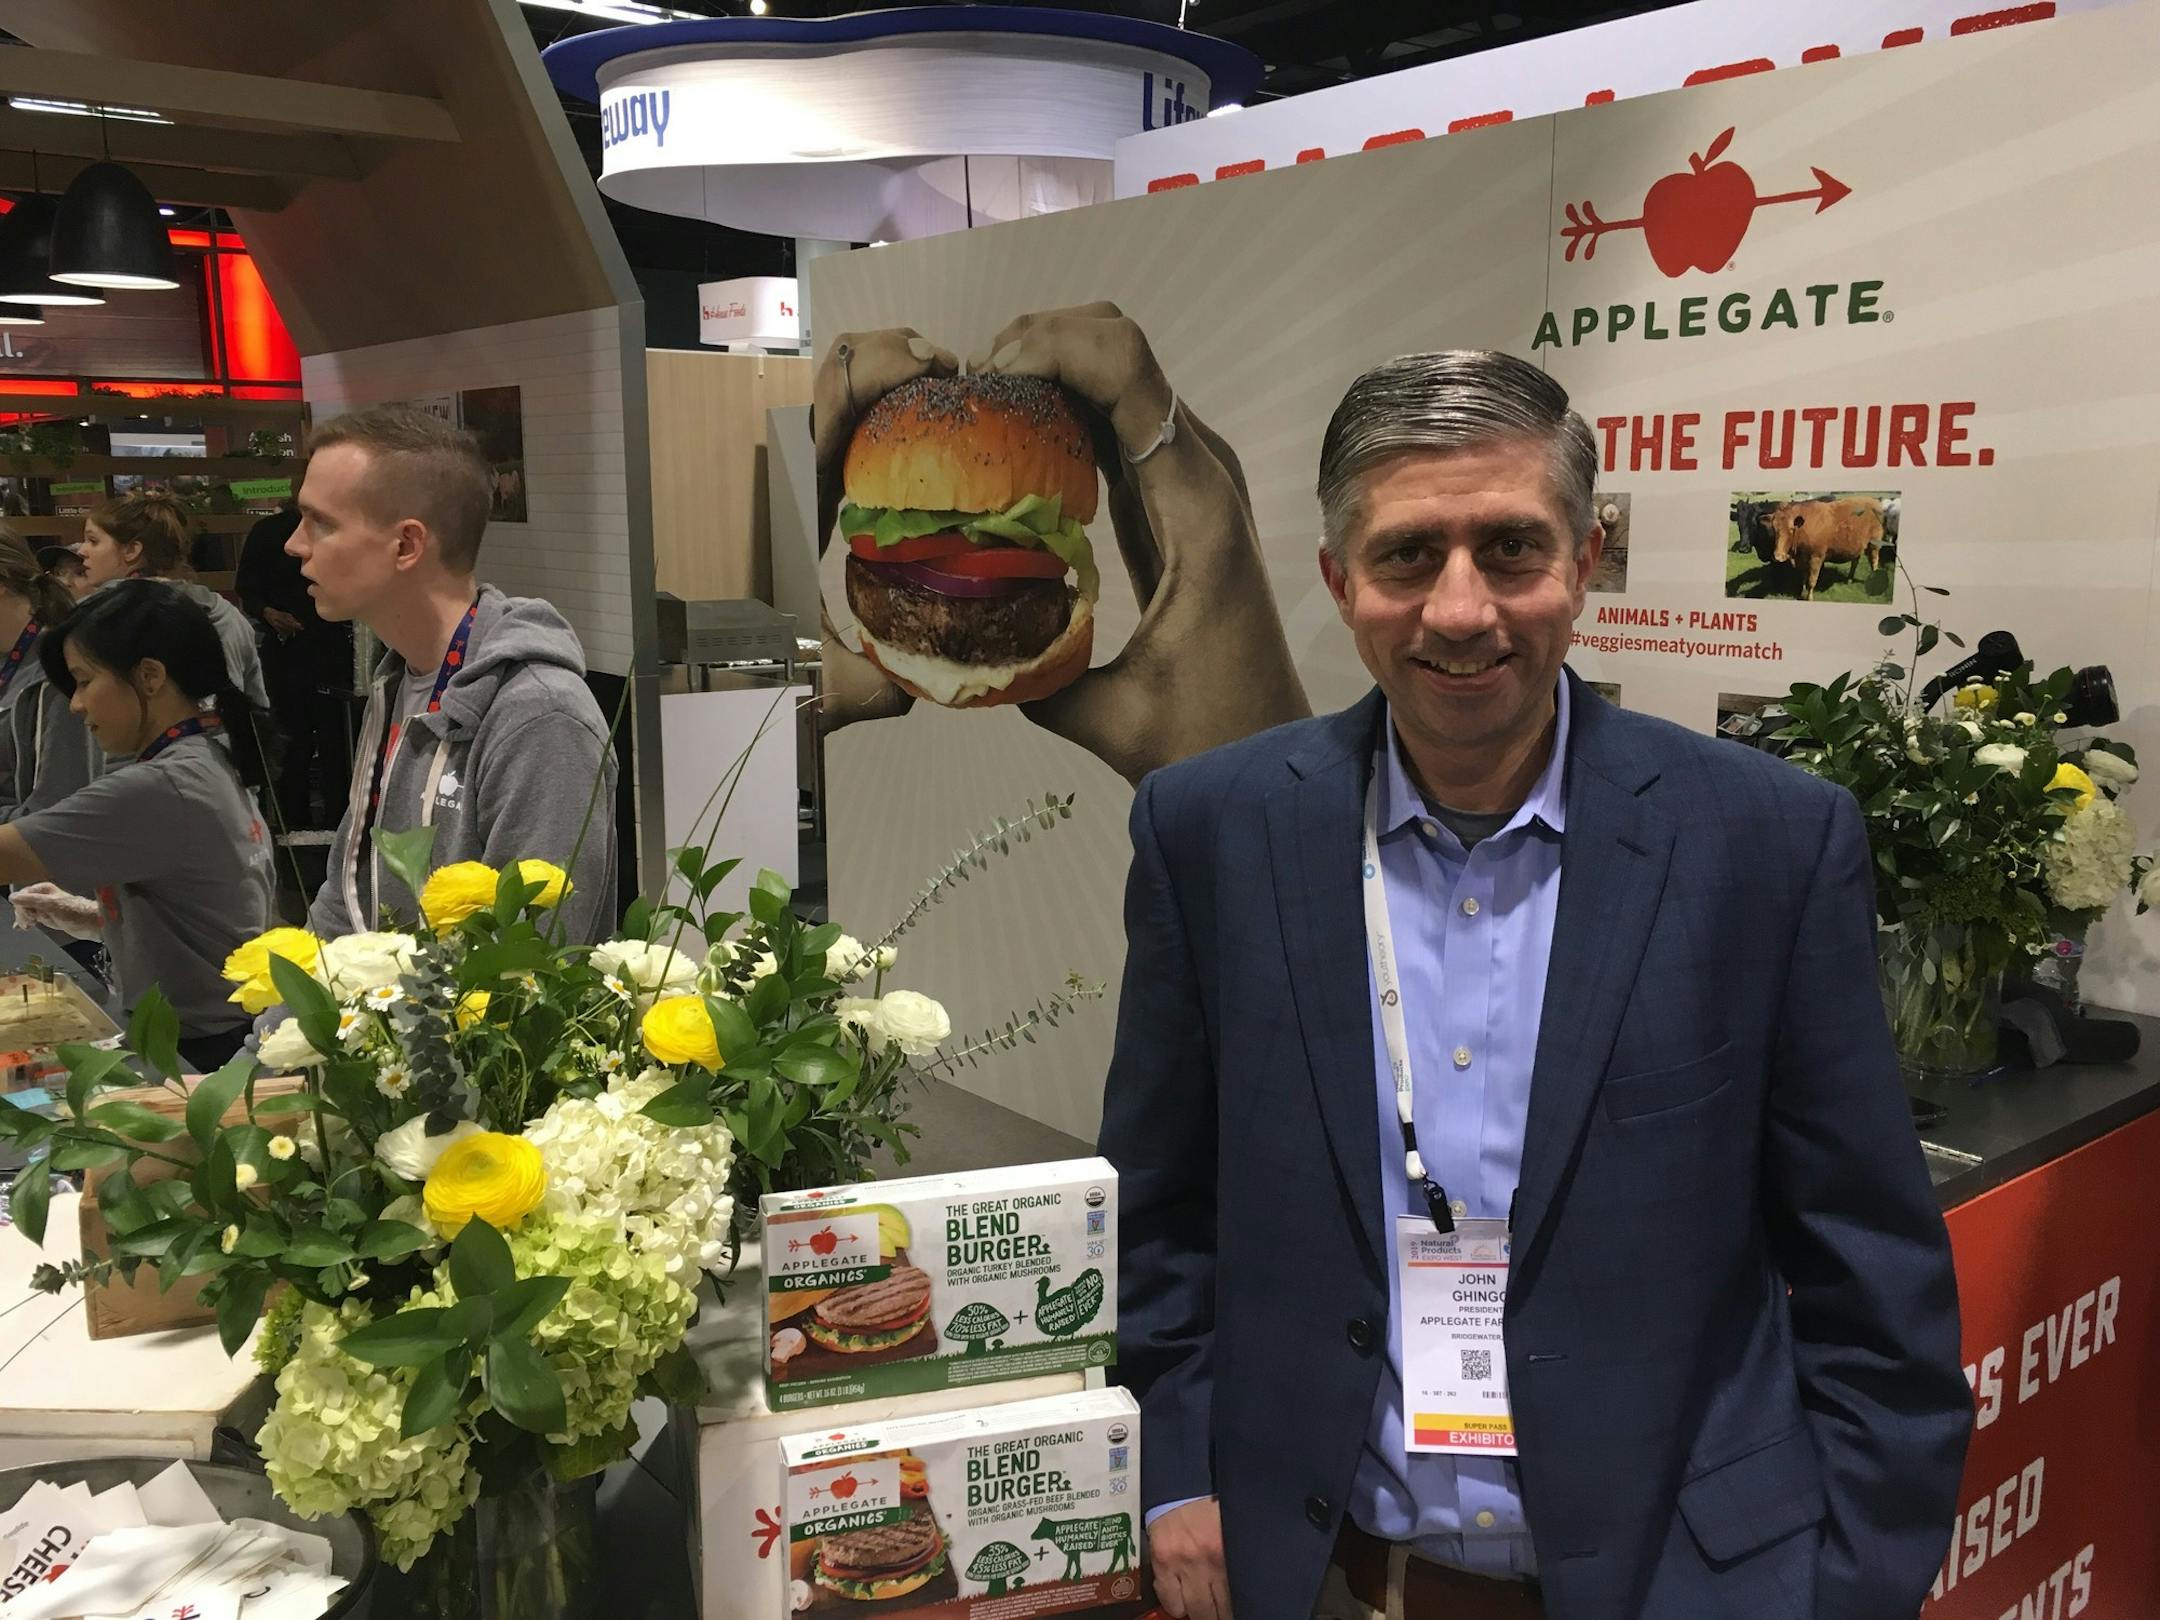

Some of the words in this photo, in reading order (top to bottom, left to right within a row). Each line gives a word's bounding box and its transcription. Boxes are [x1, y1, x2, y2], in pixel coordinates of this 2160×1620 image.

[1597, 413, 1701, 472] THE
[1722, 402, 1995, 470] FUTURE.
[1597, 607, 1669, 627] ANIMALS
[1689, 611, 1757, 632] PLANTS
[1571, 630, 1783, 661] #veggiesmeatyourmatch
[946, 1204, 968, 1217] THE
[973, 1200, 1008, 1214] GREAT
[1013, 1193, 1062, 1210] ORGANIC
[946, 1212, 1020, 1242] BLEND
[782, 1254, 868, 1271] APPLEGATE
[947, 1265, 982, 1278] ORGANIC
[983, 1261, 1013, 1272] TURKEY
[1015, 1256, 1052, 1268] BLENDED
[783, 1269, 866, 1289] ORGANICS
[947, 1275, 970, 1287] WITH
[972, 1271, 1007, 1284] ORGANIC
[1010, 1264, 1061, 1279] MUSHROOMS
[1085, 1273, 1099, 1290] NO
[1458, 1274, 1496, 1284] JOHN
[967, 1304, 989, 1317] 50%
[1038, 1293, 1073, 1318] APPLEGATE
[1040, 1303, 1074, 1325] HUMANELY
[950, 1321, 970, 1334] 70%
[970, 1323, 987, 1334] LESS
[987, 1319, 1002, 1330] FAT
[955, 1315, 971, 1324] LESS
[1420, 1316, 1482, 1326] APPLEGATE
[1963, 1346, 2005, 1430] S
[2018, 1276, 2121, 1404] EVER
[1464, 1422, 1487, 1430] SUPER
[967, 1445, 989, 1459] THE
[994, 1438, 1030, 1454] GREAT
[1034, 1431, 1084, 1446] ORGANIC
[1449, 1431, 1515, 1445] EXHIBITO
[967, 1450, 1041, 1483] BLEND
[802, 1496, 888, 1519] APPLEGATE
[967, 1505, 1000, 1518] ORGANIC
[1002, 1497, 1044, 1512] GRASS-FED
[1045, 1493, 1065, 1504] BEEF
[1066, 1489, 1101, 1502] BLENDED
[803, 1511, 886, 1535] ORGANICS
[968, 1515, 989, 1528] WITH
[991, 1510, 1024, 1523] ORGANIC
[1026, 1502, 1076, 1516] MUSHROOMS
[1055, 1521, 1099, 1535] APPLEGATE
[1055, 1531, 1099, 1544] HUMANELY
[976, 1555, 993, 1565] LESS
[988, 1544, 1009, 1557] 35%
[991, 1561, 1007, 1573] LESS
[1007, 1556, 1023, 1569] FAT
